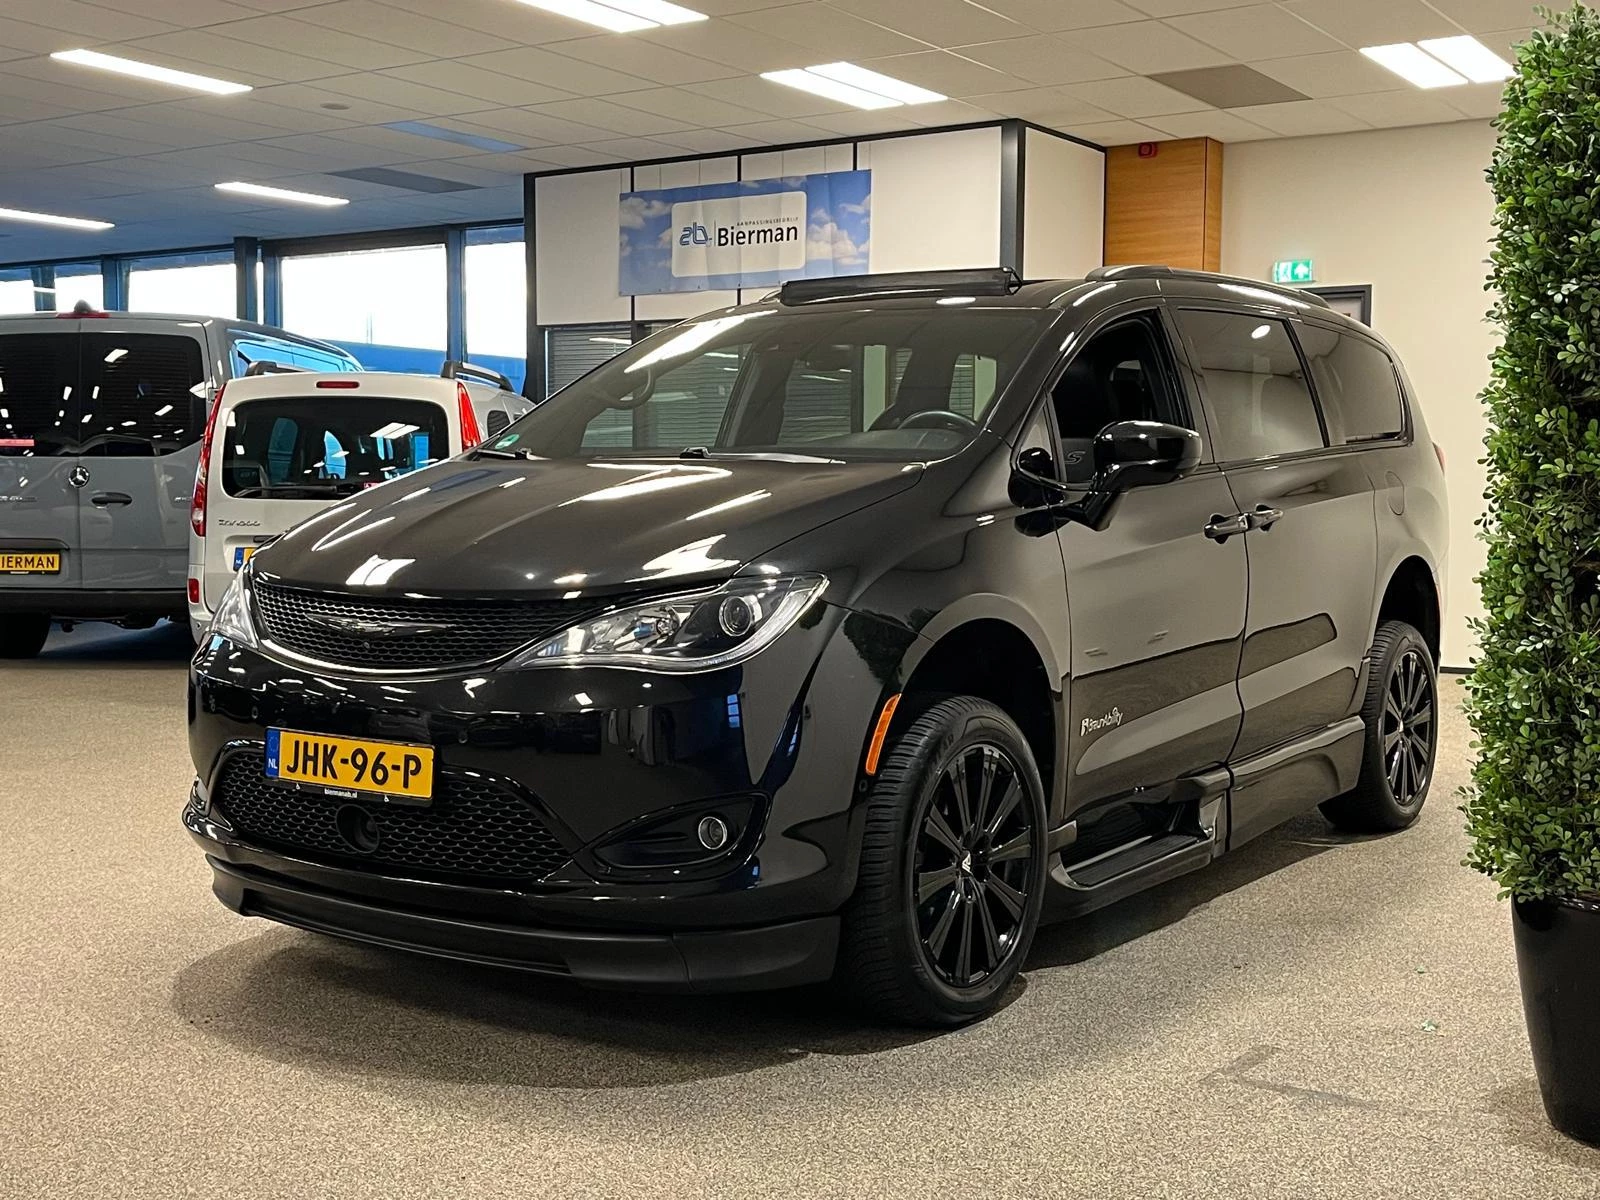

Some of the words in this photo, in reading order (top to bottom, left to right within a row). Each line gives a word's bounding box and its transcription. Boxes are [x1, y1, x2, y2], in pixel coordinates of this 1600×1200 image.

[717, 226, 798, 246] Bierman
[267, 757, 279, 770] NL
[286, 740, 422, 789] JHK-96-P
